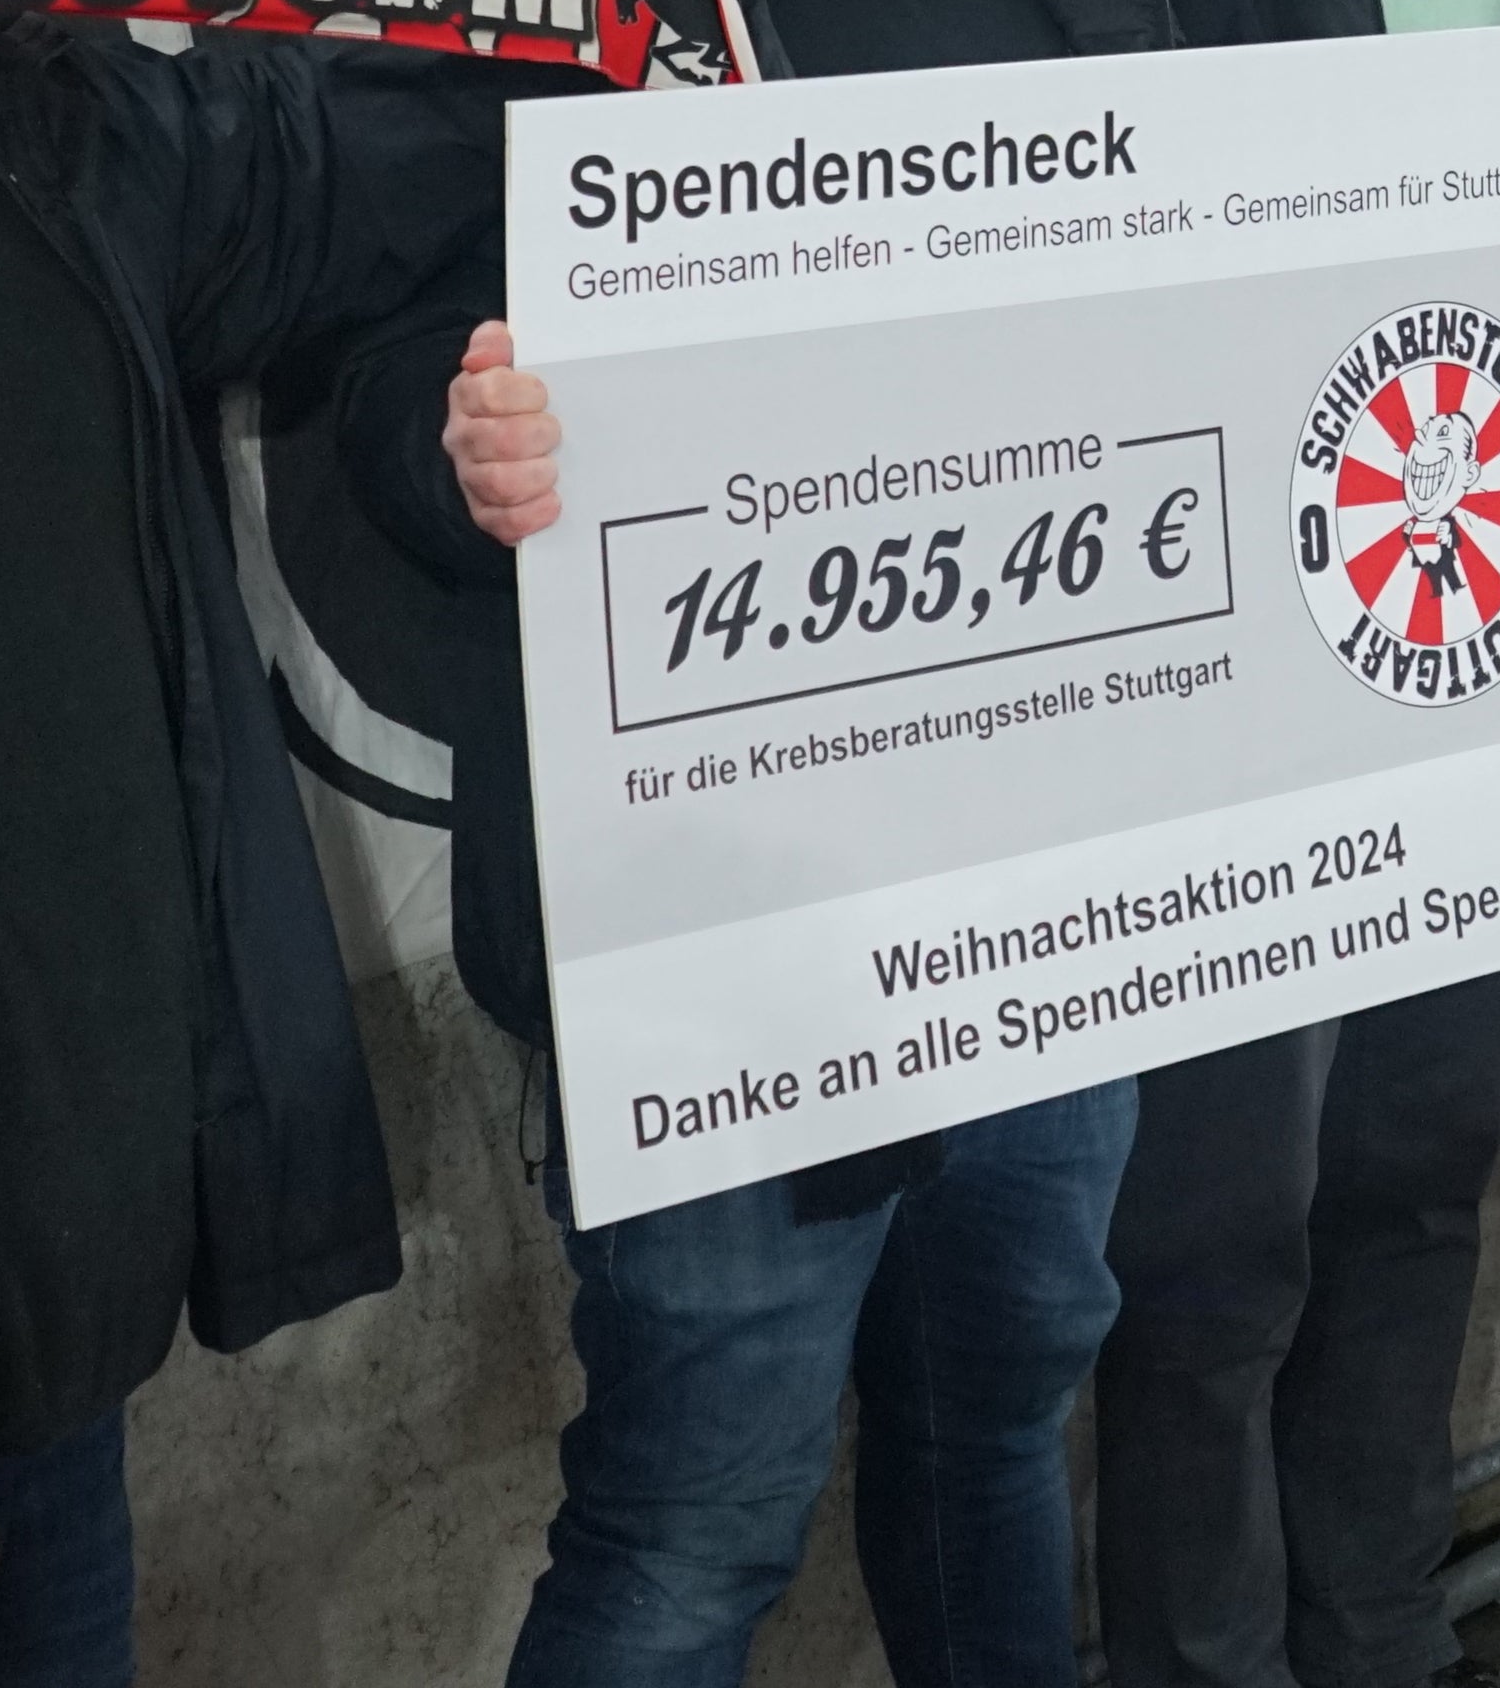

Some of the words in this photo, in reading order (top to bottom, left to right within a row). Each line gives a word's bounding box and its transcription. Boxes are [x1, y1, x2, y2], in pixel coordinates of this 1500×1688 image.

[567, 250, 780, 301] Gemeinsam
[791, 233, 891, 276] helfen
[926, 215, 1112, 260] Gemeinsam
[1123, 199, 1194, 238] stark
[1223, 185, 1389, 227] Gemeinsam
[1398, 173, 1434, 208] für
[568, 112, 1137, 241] Spendenscheck
[725, 433, 1103, 535] Spendensumme
[1300, 504, 1329, 574] 0
[664, 502, 1109, 674] 14.955,46
[1138, 487, 1199, 580] €
[624, 765, 675, 806] für
[686, 753, 738, 792] die
[749, 681, 1095, 780] Krebsberatungsstelle
[1104, 651, 1234, 705] Stuttgart
[871, 860, 1295, 999] Weihnachtsaktion
[1307, 821, 1407, 891] 2024
[632, 1067, 800, 1151] Danke
[818, 1049, 879, 1100] an
[896, 1016, 981, 1078] alle
[997, 933, 1318, 1056] Spenderinnen
[1330, 896, 1410, 960] und
